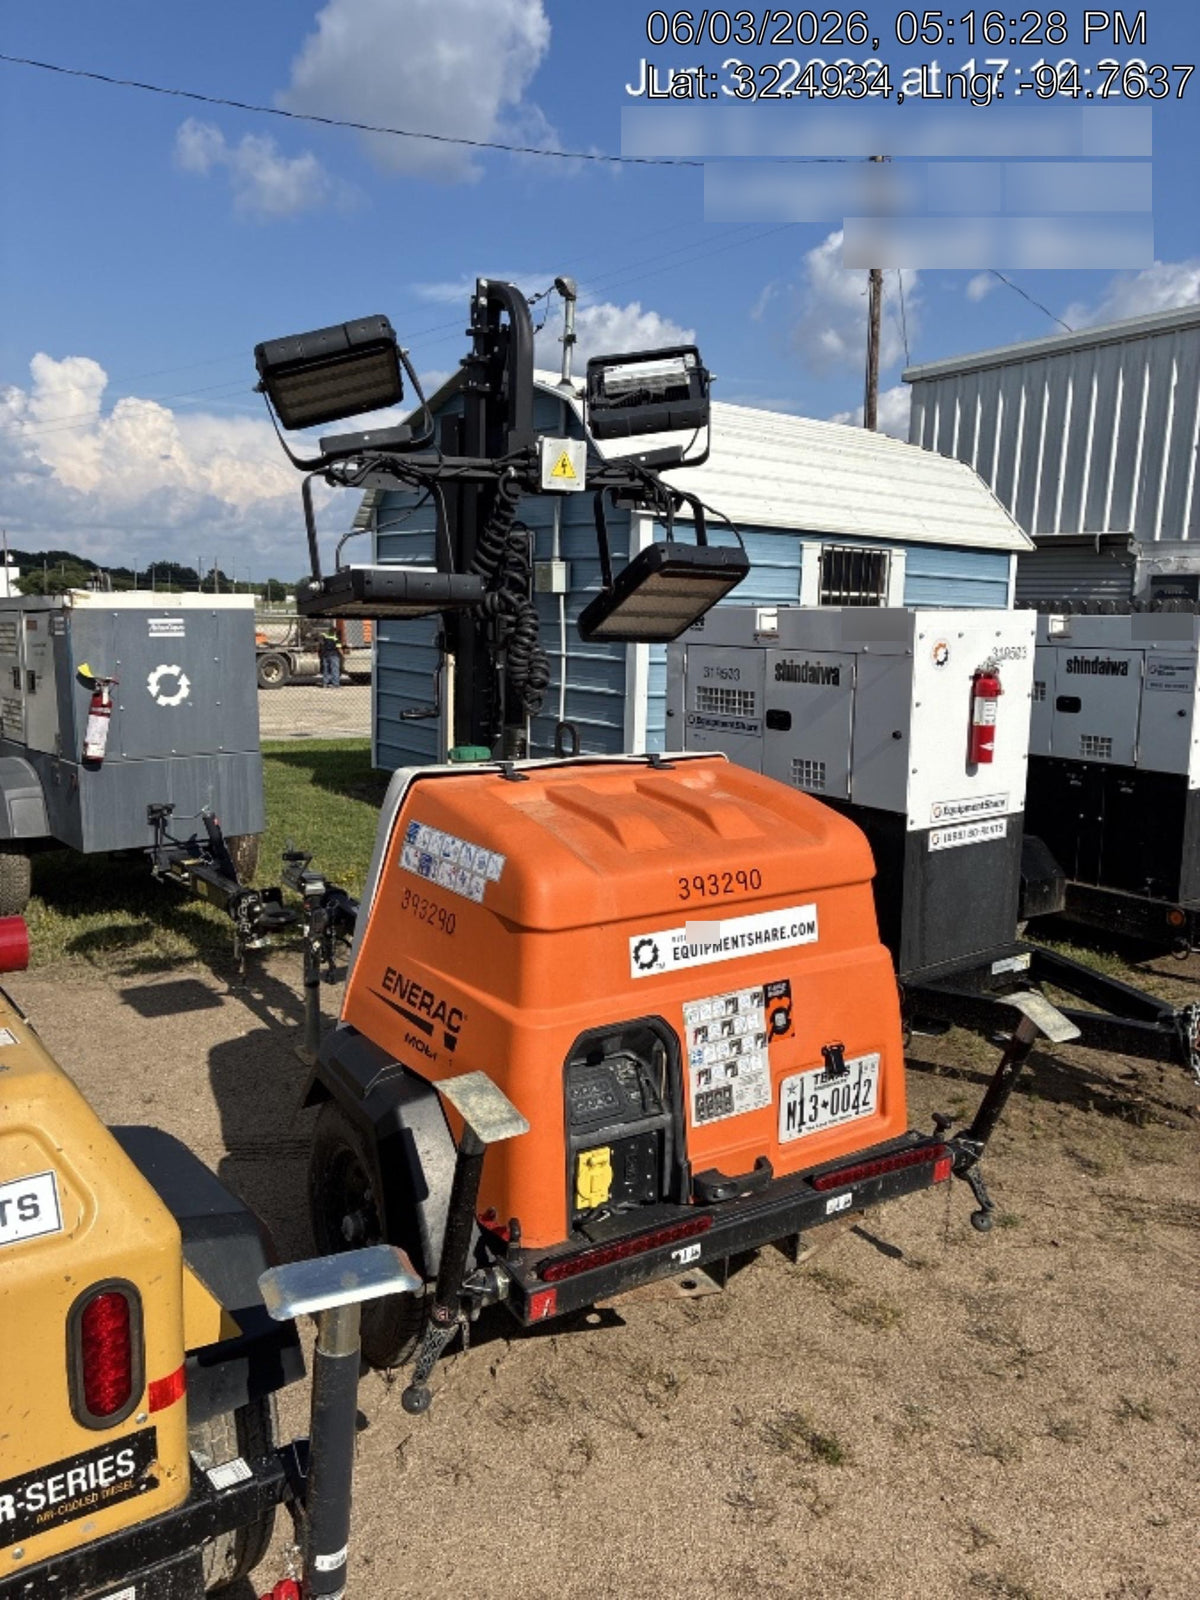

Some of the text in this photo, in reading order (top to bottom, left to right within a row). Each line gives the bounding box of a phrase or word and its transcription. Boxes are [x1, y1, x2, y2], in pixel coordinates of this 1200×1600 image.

[775, 659, 840, 686] shindaiwa
[1066, 655, 1129, 676] shindaiwa
[678, 869, 762, 900] 393290
[401, 888, 457, 935] 393290
[673, 920, 816, 961] EQUIPMENTSHARE.COM
